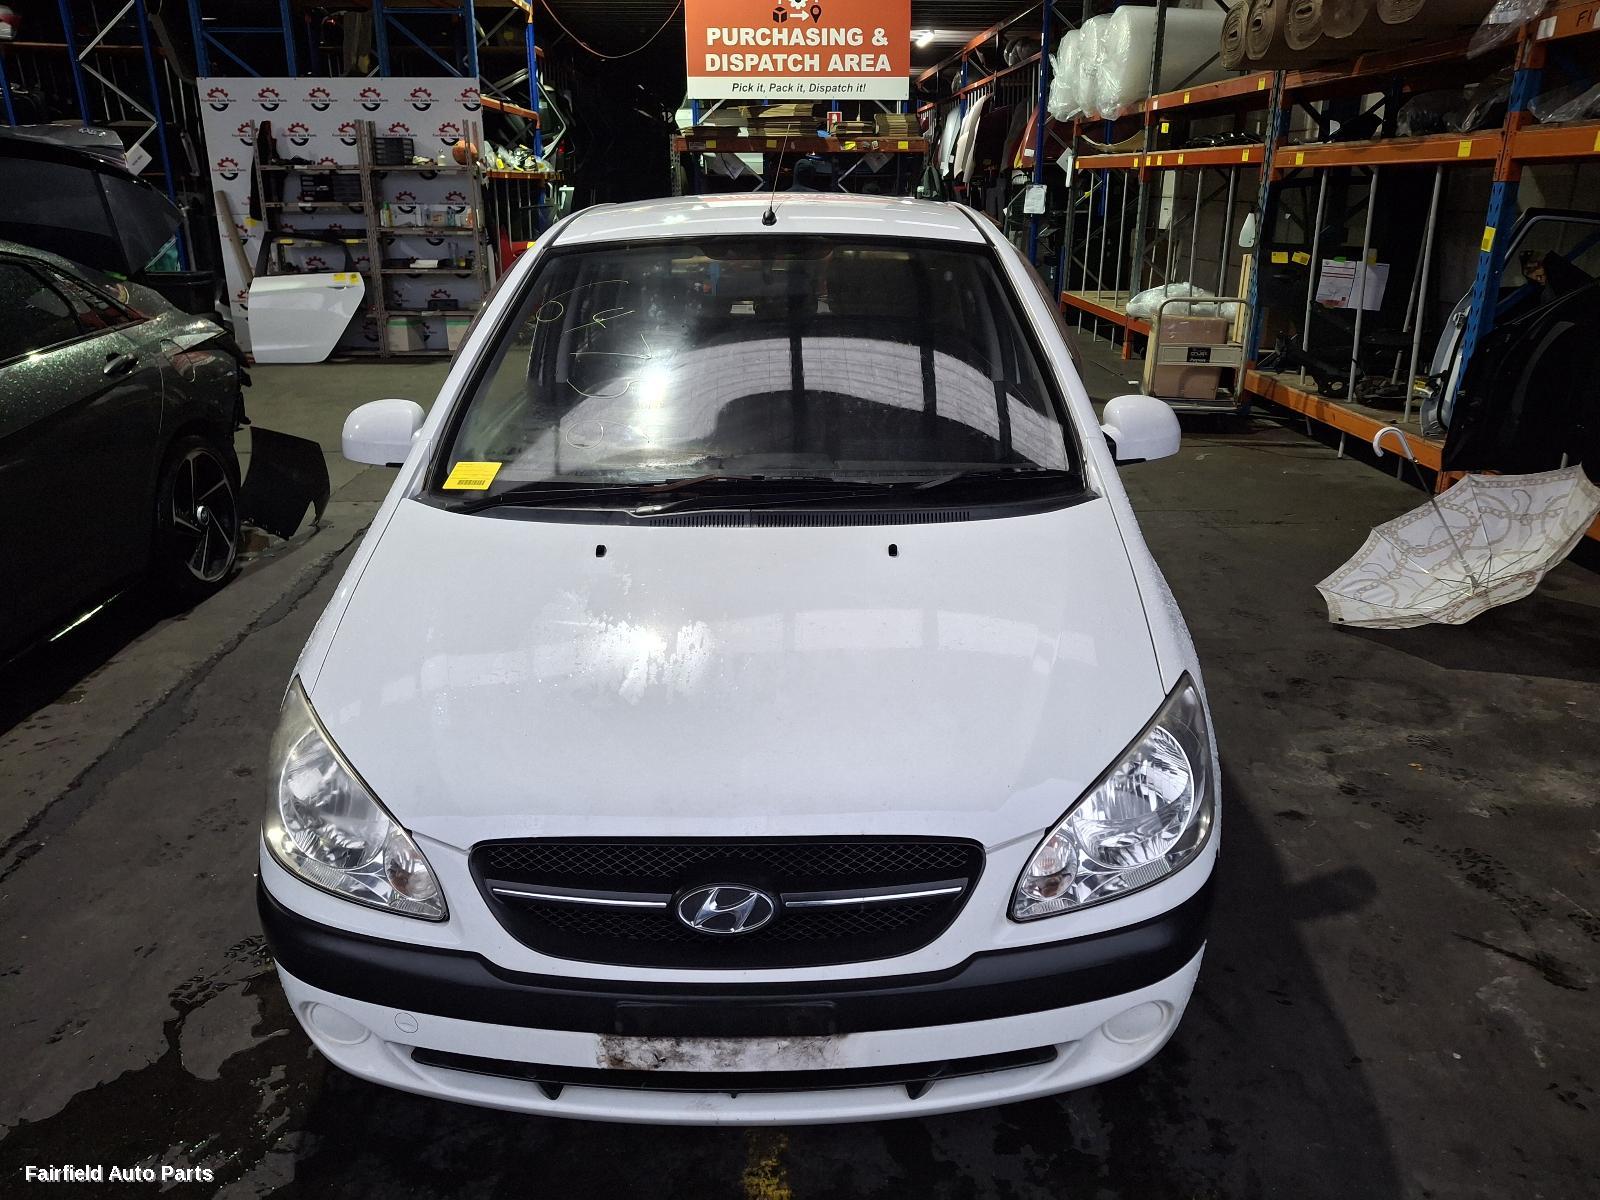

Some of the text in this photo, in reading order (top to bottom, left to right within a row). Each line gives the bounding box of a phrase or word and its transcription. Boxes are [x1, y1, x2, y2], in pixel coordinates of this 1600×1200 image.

[706, 27, 889, 47] PURCHASING &
[705, 53, 892, 72] DISPATCH AREA
[732, 83, 867, 94] Pick it, Pack it, Dispatch it!
